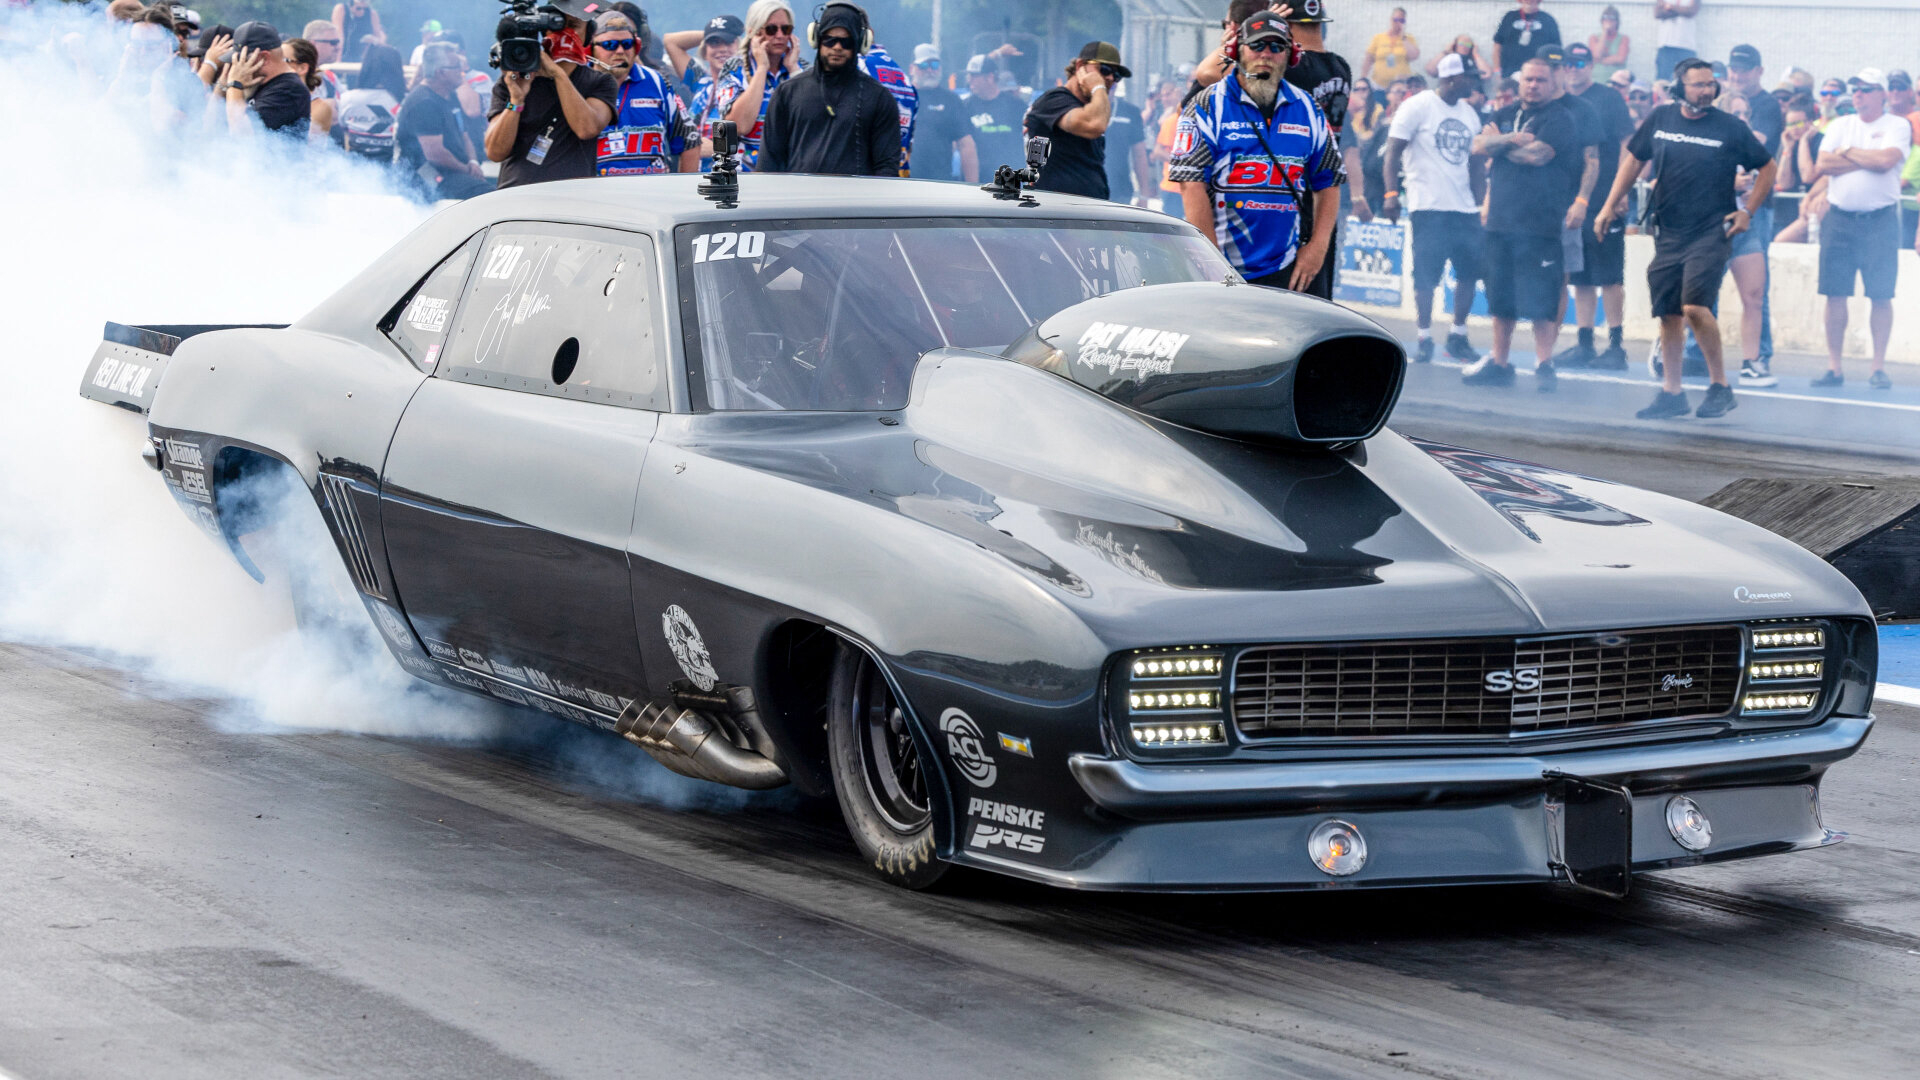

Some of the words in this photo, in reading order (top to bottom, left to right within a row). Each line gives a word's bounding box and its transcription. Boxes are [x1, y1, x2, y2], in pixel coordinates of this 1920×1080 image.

[482, 244, 524, 280] 120
[692, 231, 766, 264] 120
[418, 305, 449, 326] HAYES
[425, 297, 448, 309] ROBERT
[1077, 321, 1128, 349] PAT
[1117, 326, 1190, 360] MUSI
[92, 357, 120, 388] RED
[108, 361, 140, 394] LINE
[129, 366, 153, 398] OIL
[1077, 343, 1122, 376] Racing
[1120, 350, 1174, 379] Engines
[165, 435, 205, 470] Strange
[181, 470, 210, 496] JESEL
[1733, 586, 1792, 603] Camaro
[1484, 667, 1540, 693] SS
[947, 731, 995, 764] ACL
[967, 797, 1046, 831] PENSKE
[970, 823, 1046, 854] PRS
